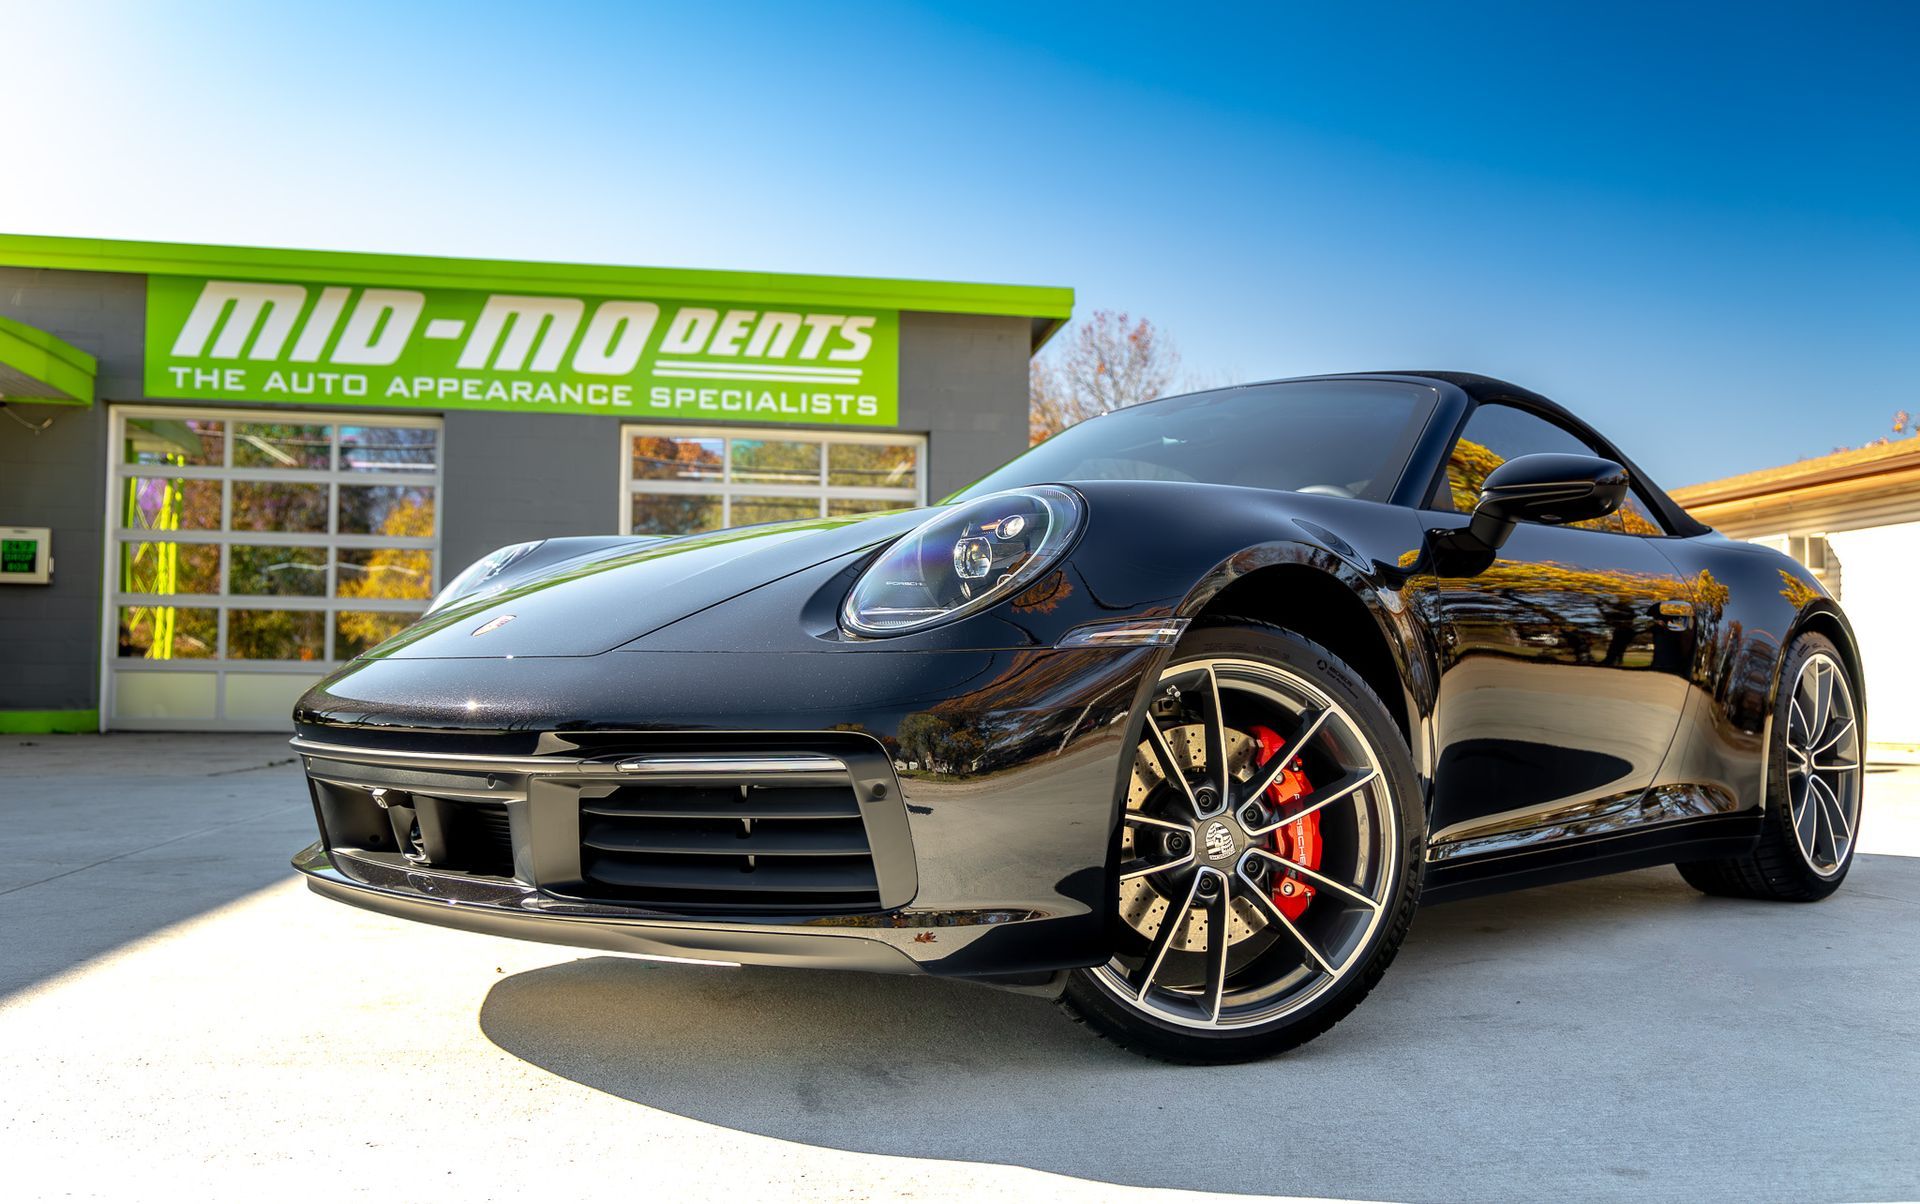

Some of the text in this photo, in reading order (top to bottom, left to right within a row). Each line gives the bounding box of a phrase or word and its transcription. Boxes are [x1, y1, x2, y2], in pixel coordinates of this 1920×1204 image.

[170, 280, 877, 376] MID-MO DENTS
[168, 366, 878, 417] THE AUTO APPEARANCE SPECIALISTS
